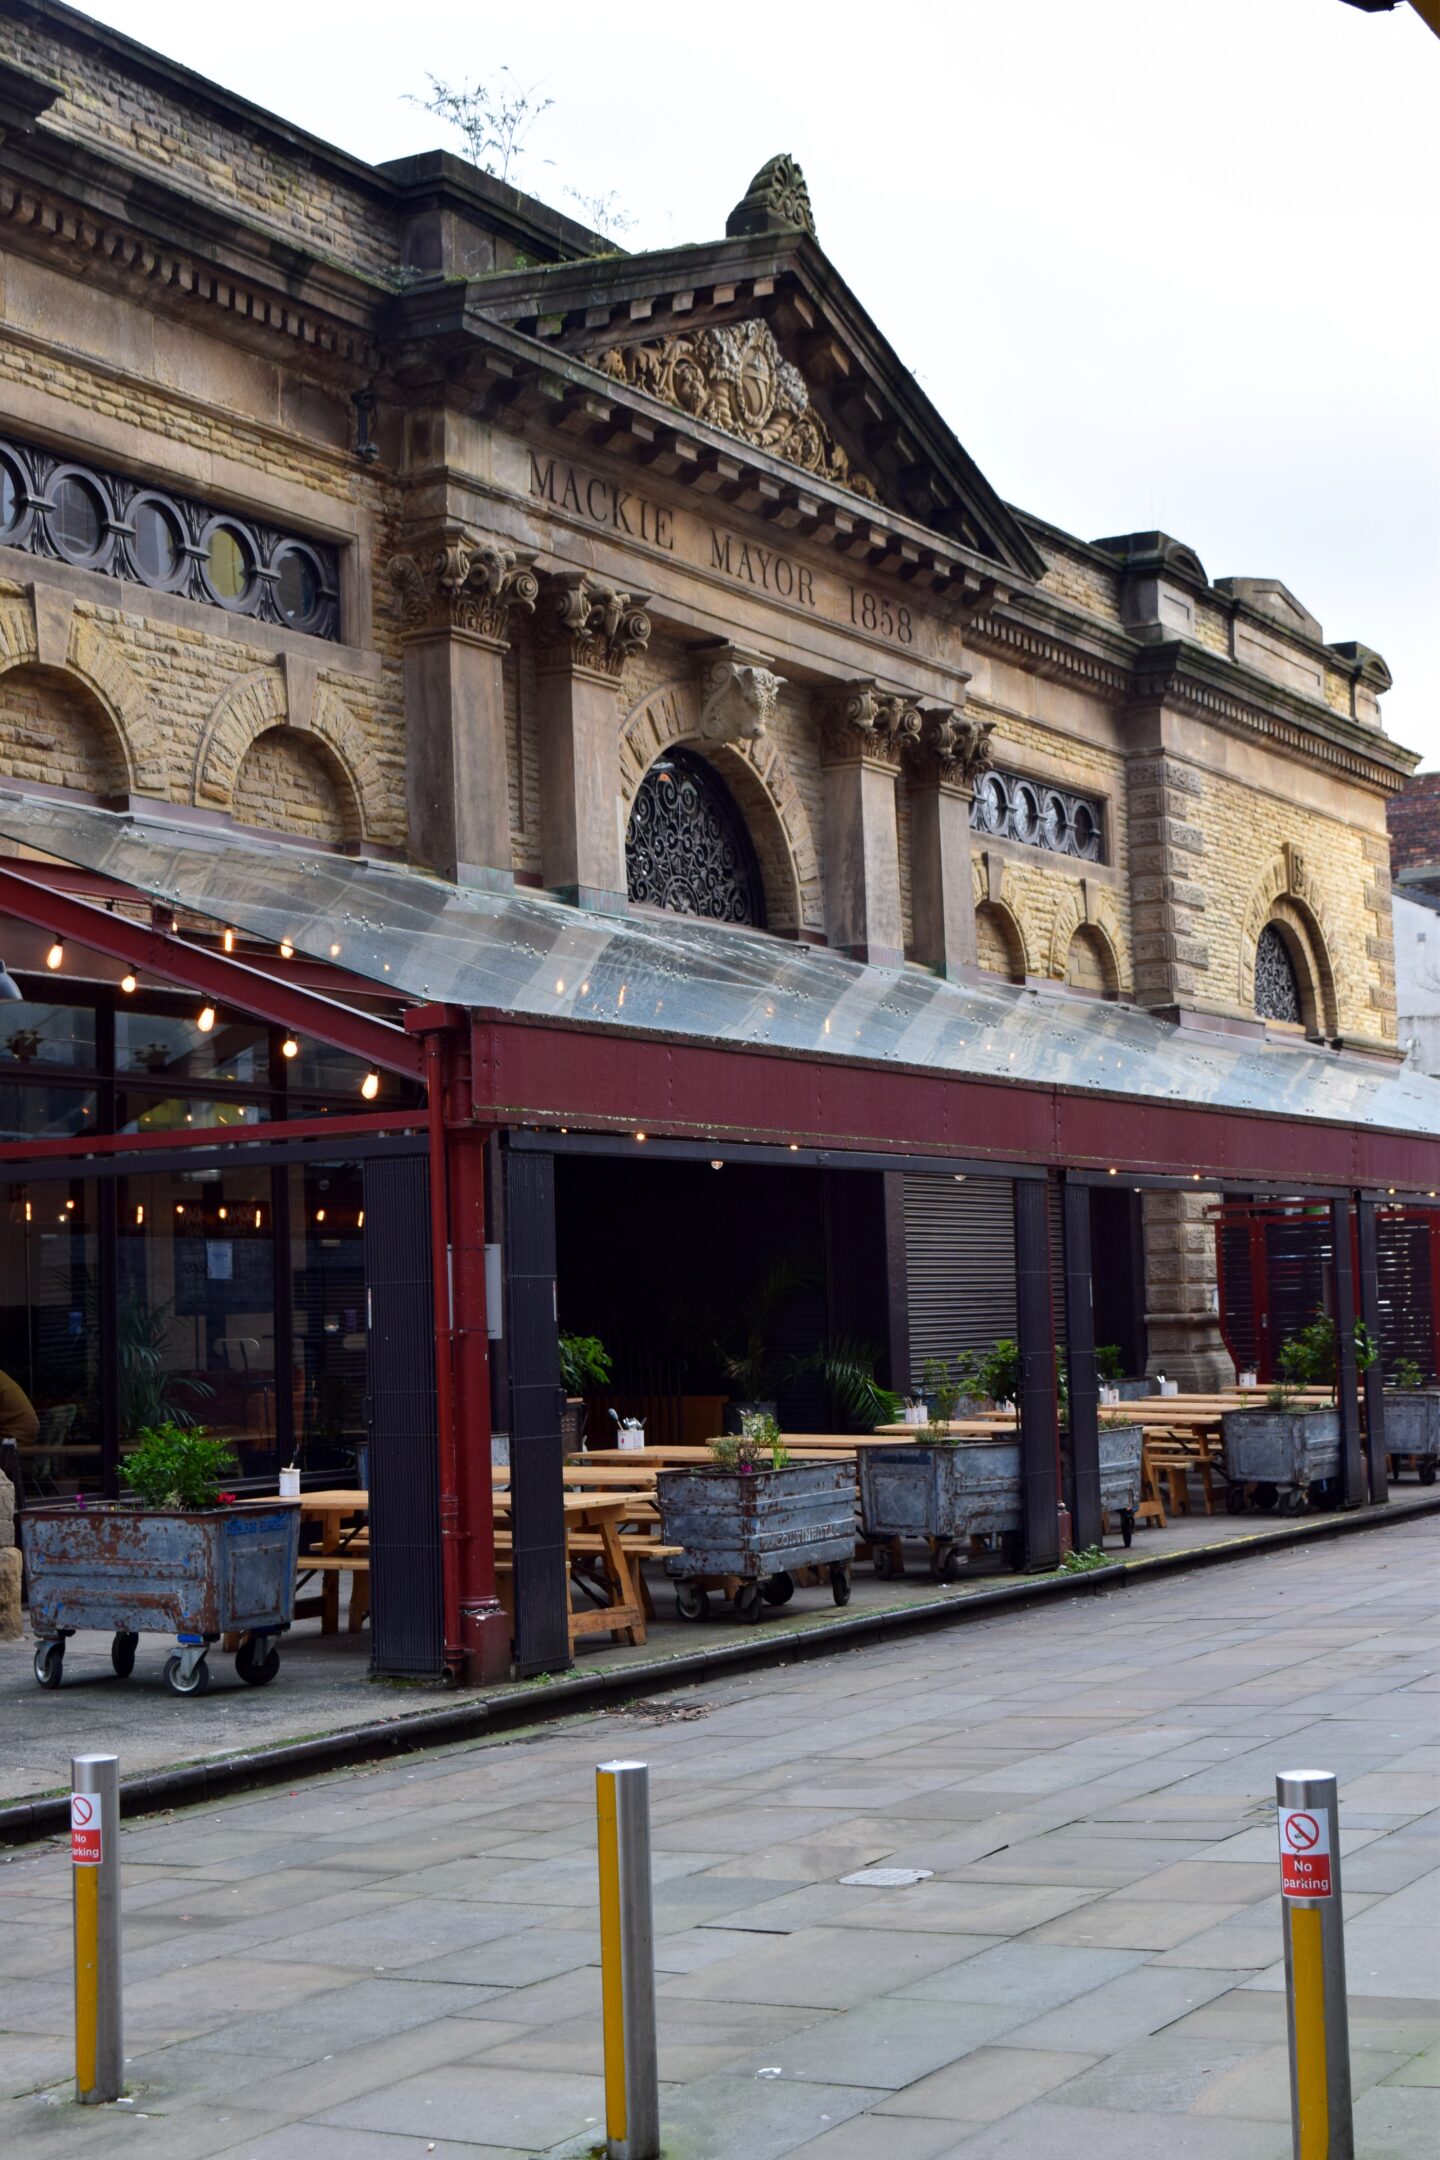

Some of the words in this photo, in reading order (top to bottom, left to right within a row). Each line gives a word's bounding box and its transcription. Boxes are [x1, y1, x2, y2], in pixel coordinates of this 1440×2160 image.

[529, 451, 674, 550] MACKIE
[709, 528, 815, 607] MAYOR
[848, 584, 912, 644] 1858
[75, 1833, 86, 1843] No
[73, 1847, 99, 1858] arking
[1294, 1860, 1312, 1872] No
[1283, 1878, 1328, 1890] parking
